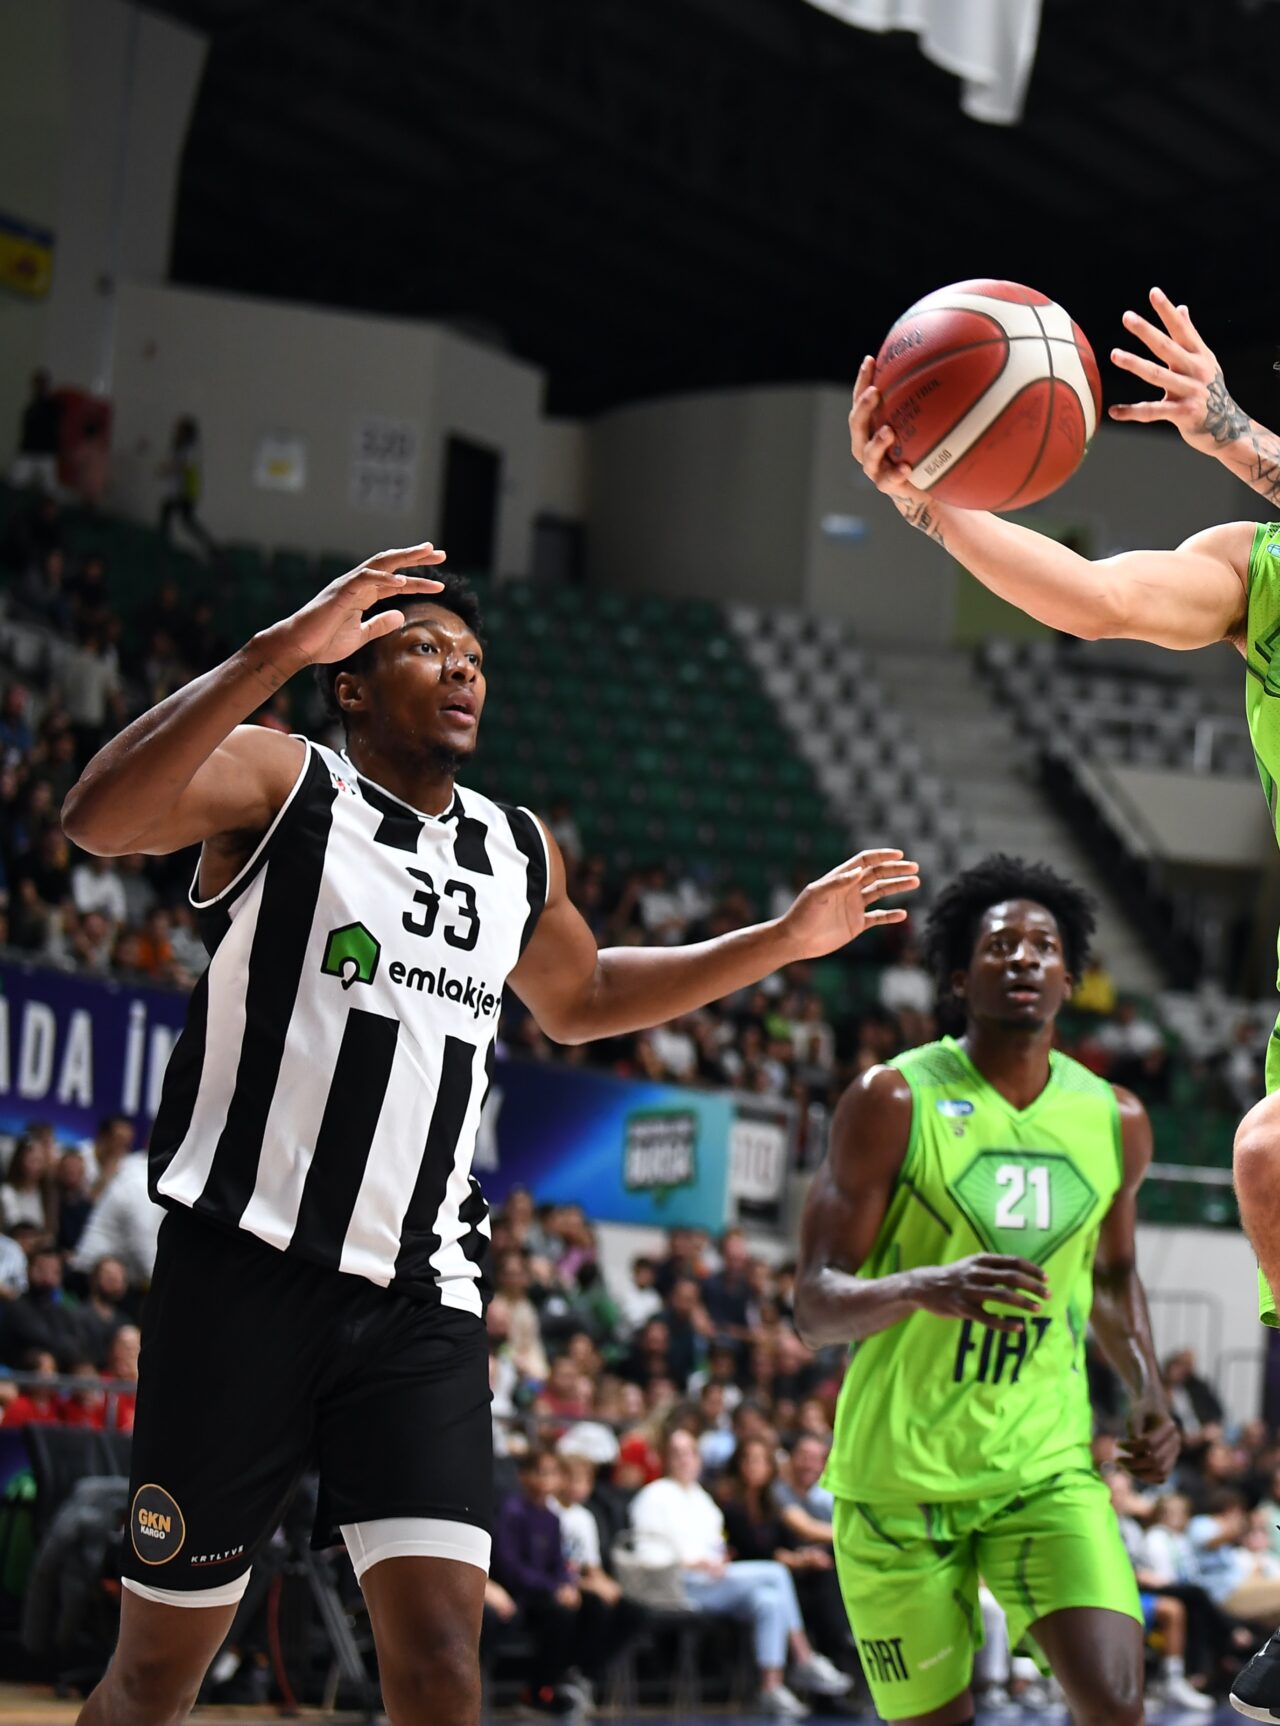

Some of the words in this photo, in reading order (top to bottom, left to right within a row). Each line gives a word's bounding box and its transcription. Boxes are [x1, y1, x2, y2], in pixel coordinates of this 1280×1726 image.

[402, 867, 480, 951] 33
[995, 1164, 1051, 1230] 21
[138, 1508, 171, 1533] GKN
[140, 1526, 166, 1540] KARGO
